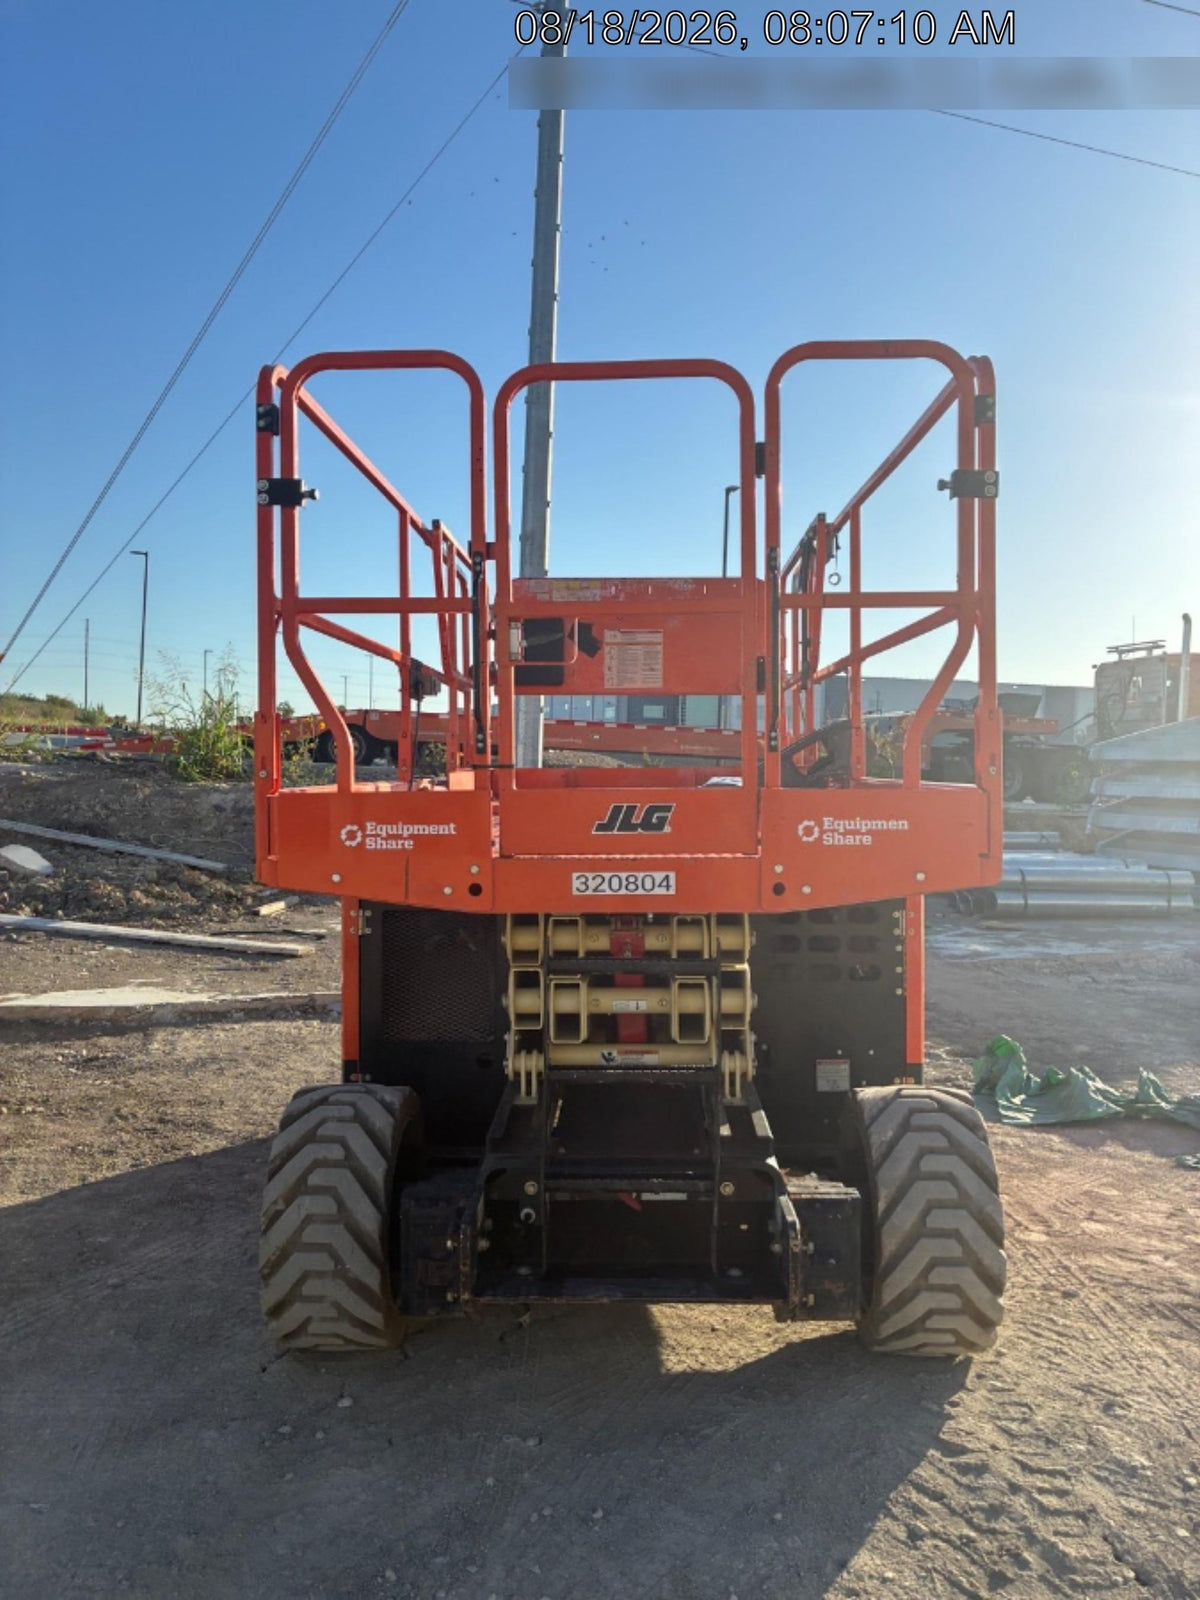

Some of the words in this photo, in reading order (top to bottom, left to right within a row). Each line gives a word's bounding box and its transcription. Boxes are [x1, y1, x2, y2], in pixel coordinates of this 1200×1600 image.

[593, 803, 675, 834] JLG
[822, 817, 909, 832] Equipmen
[365, 822, 456, 837] Equipment
[365, 837, 413, 849] Share
[822, 832, 872, 846] Share
[575, 874, 672, 893] 320804
